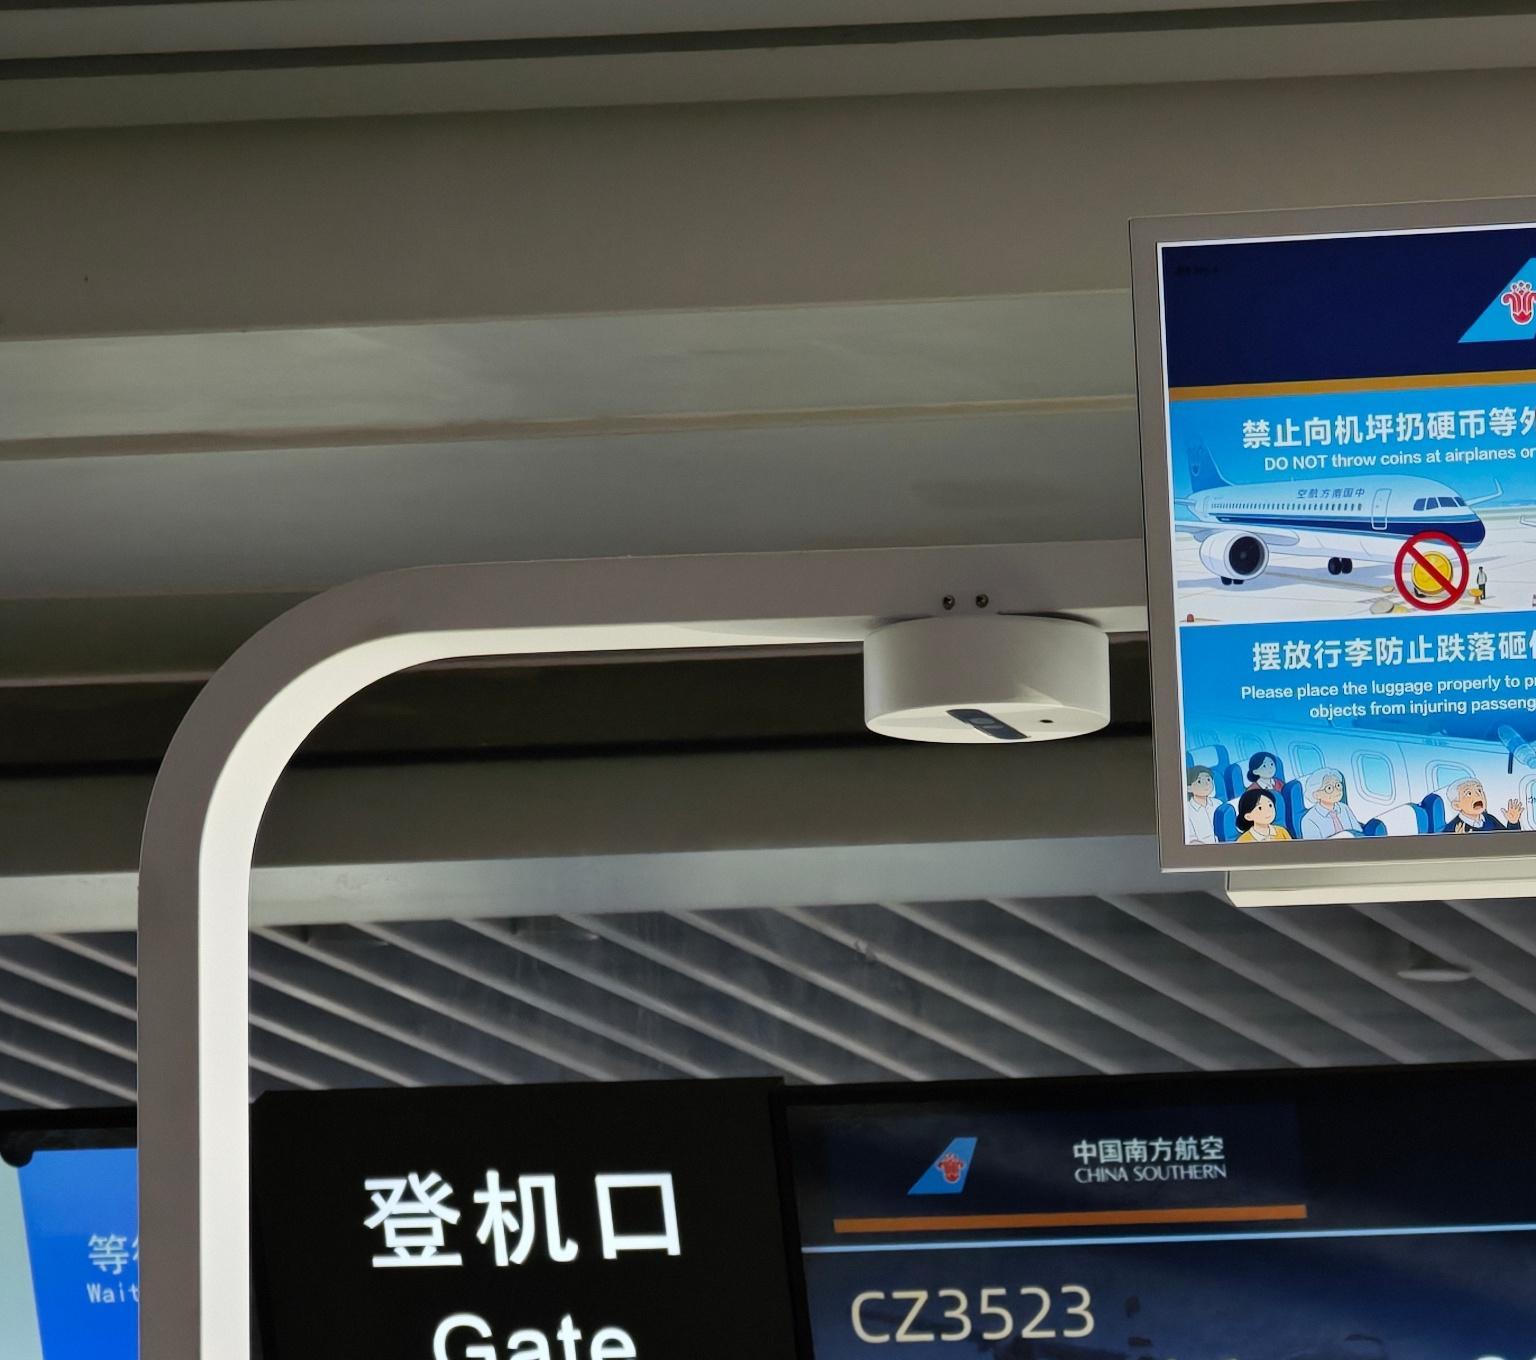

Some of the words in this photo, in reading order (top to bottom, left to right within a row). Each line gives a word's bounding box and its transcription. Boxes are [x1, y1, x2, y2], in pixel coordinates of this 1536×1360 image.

[1265, 457, 1288, 471] DO
[1293, 454, 1328, 470] NOT
[1332, 453, 1376, 468] throw
[1380, 451, 1421, 466] coins
[1426, 450, 1440, 463] at
[1445, 447, 1516, 464] airplanes
[1520, 447, 1536, 459] or
[1242, 685, 1293, 699] Please
[1297, 683, 1338, 700] place
[1343, 681, 1367, 695] the
[1372, 680, 1433, 697] luggage
[1438, 675, 1500, 694] properly
[1505, 675, 1520, 688] to
[1310, 703, 1366, 721] objects
[1370, 701, 1405, 716] from
[1410, 699, 1467, 717] injuring
[1073, 1135, 1225, 1165] 中国南方航空
[1075, 1166, 1128, 1183] CHINA
[1133, 1163, 1226, 1181] SOUTHERN
[364, 1170, 680, 1267] 登机口
[88, 1234, 139, 1275] 等
[86, 1282, 139, 1303] Wait
[852, 1285, 1094, 1343] CZ3523
